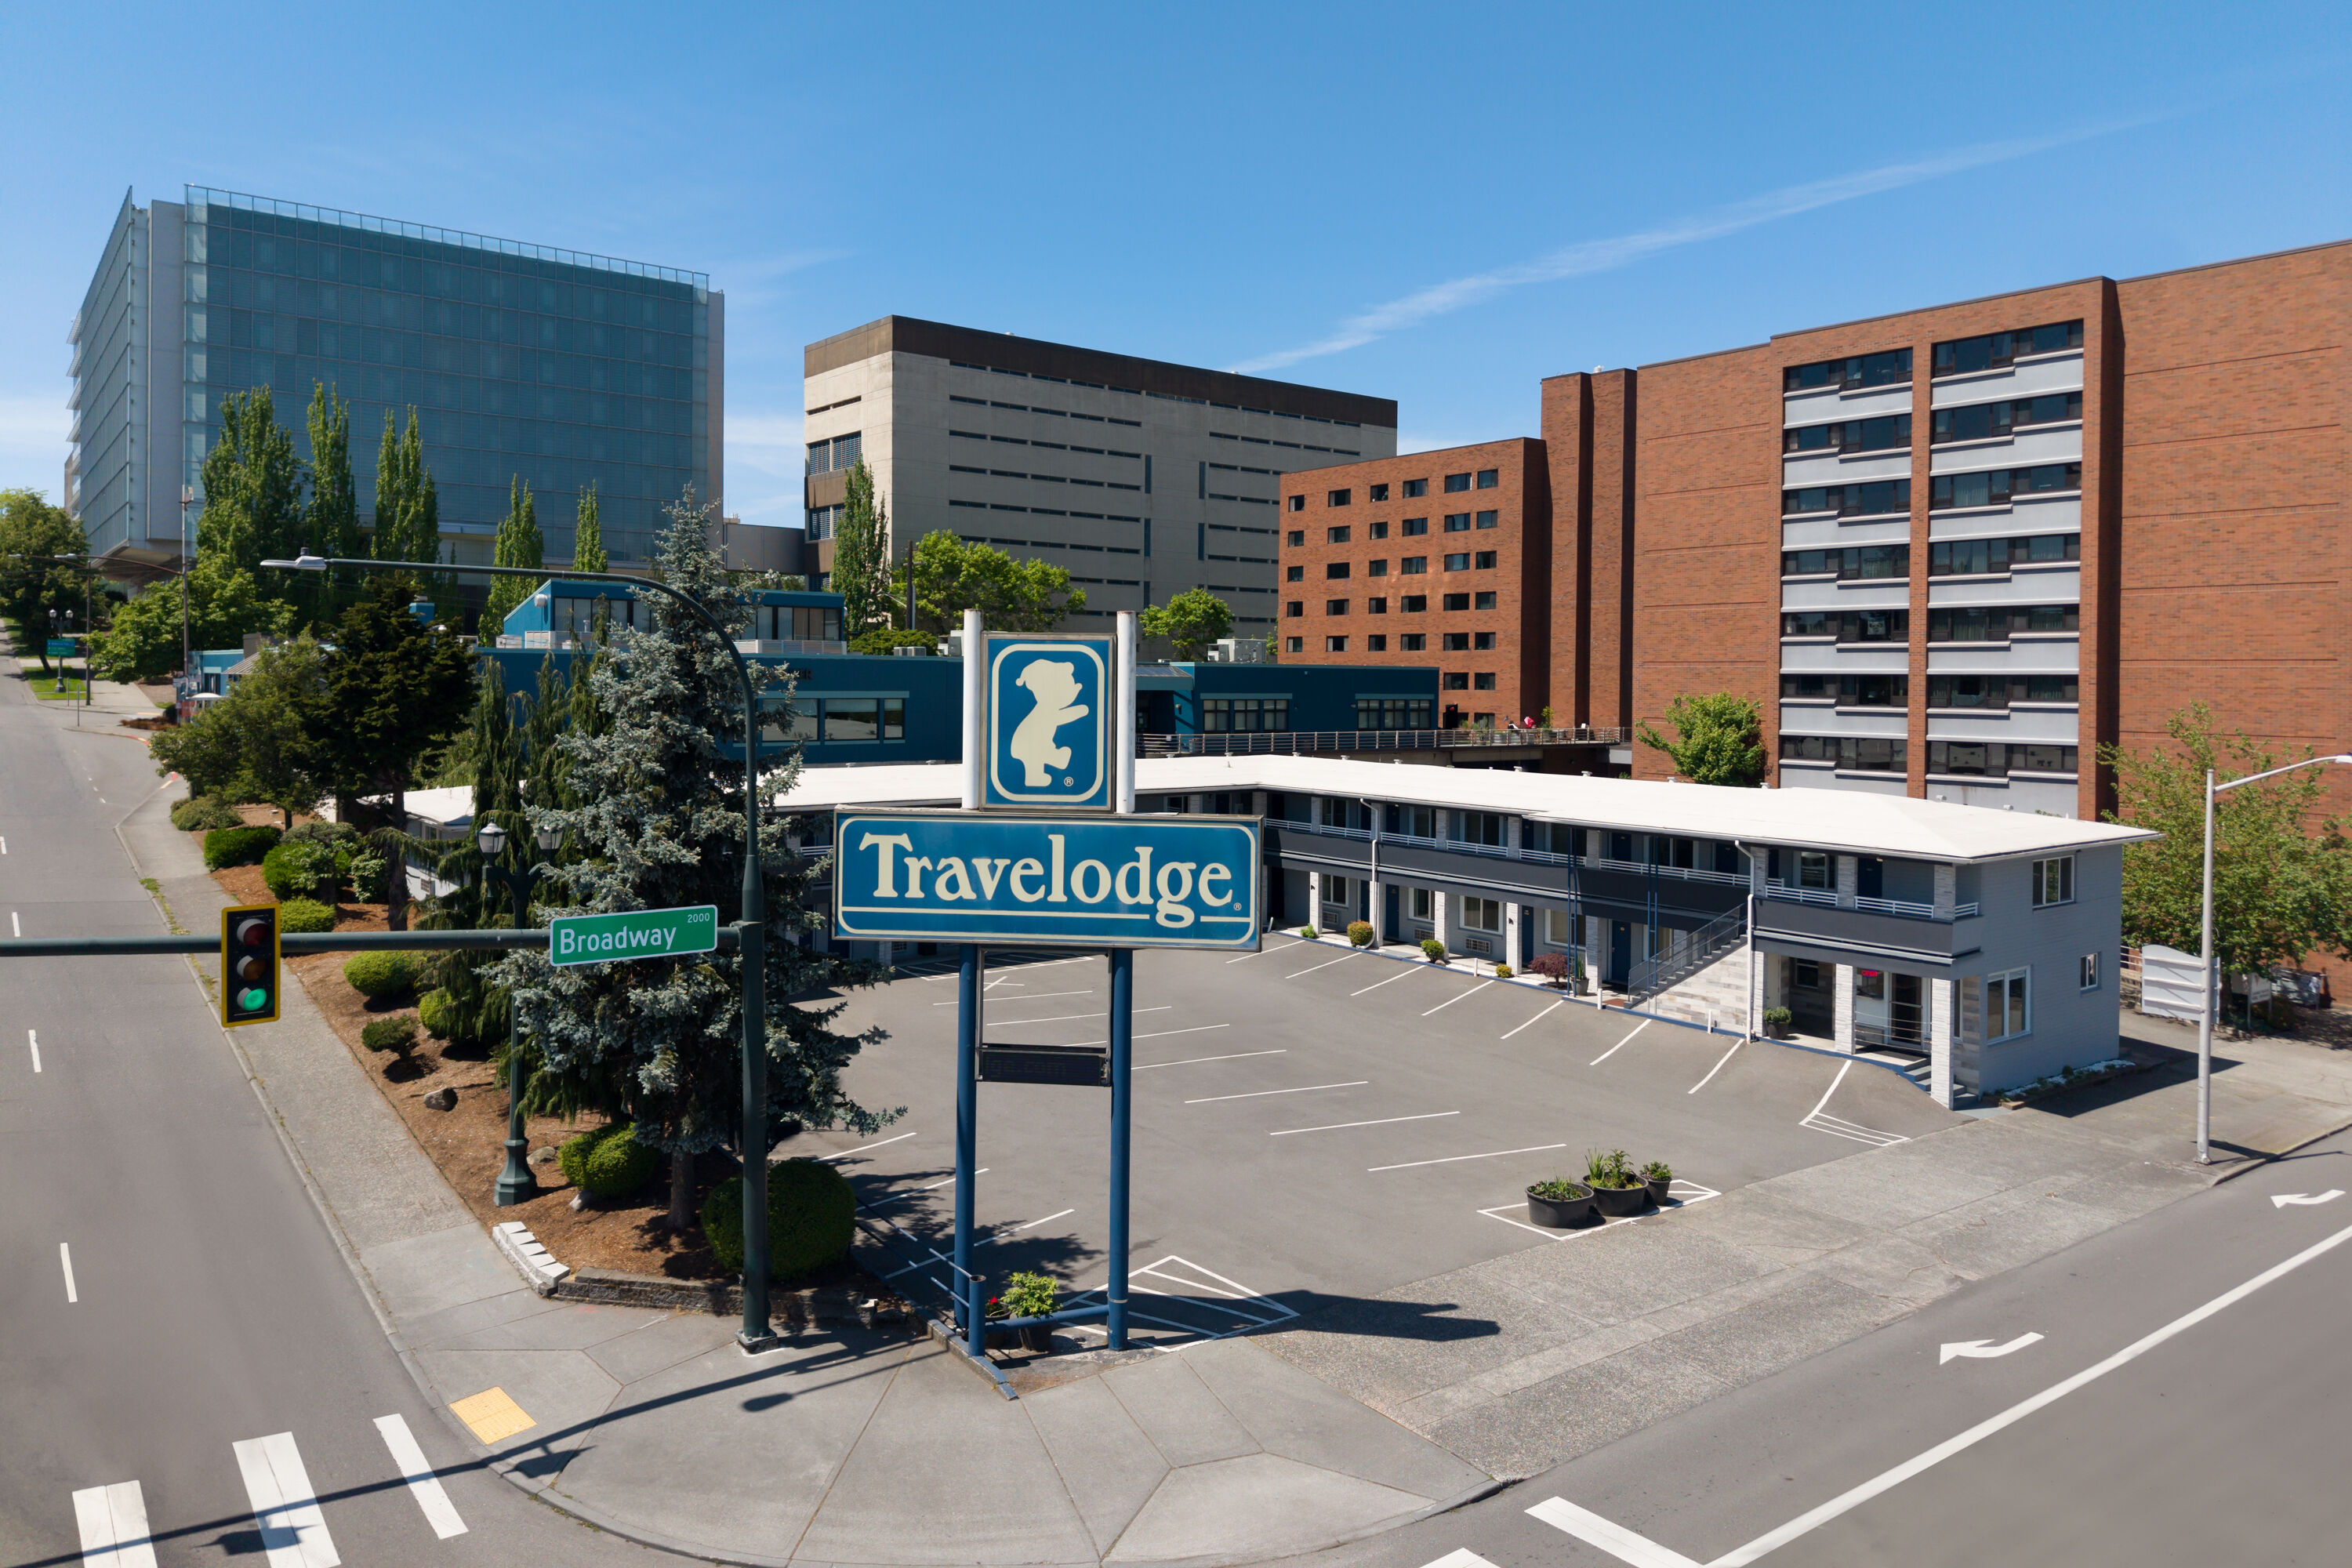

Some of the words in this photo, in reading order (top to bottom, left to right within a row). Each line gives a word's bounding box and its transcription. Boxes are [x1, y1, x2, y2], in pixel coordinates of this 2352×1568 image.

[858, 832, 1233, 928] Travelodge
[687, 913, 710, 924] 2000
[561, 927, 677, 953] Broadway
